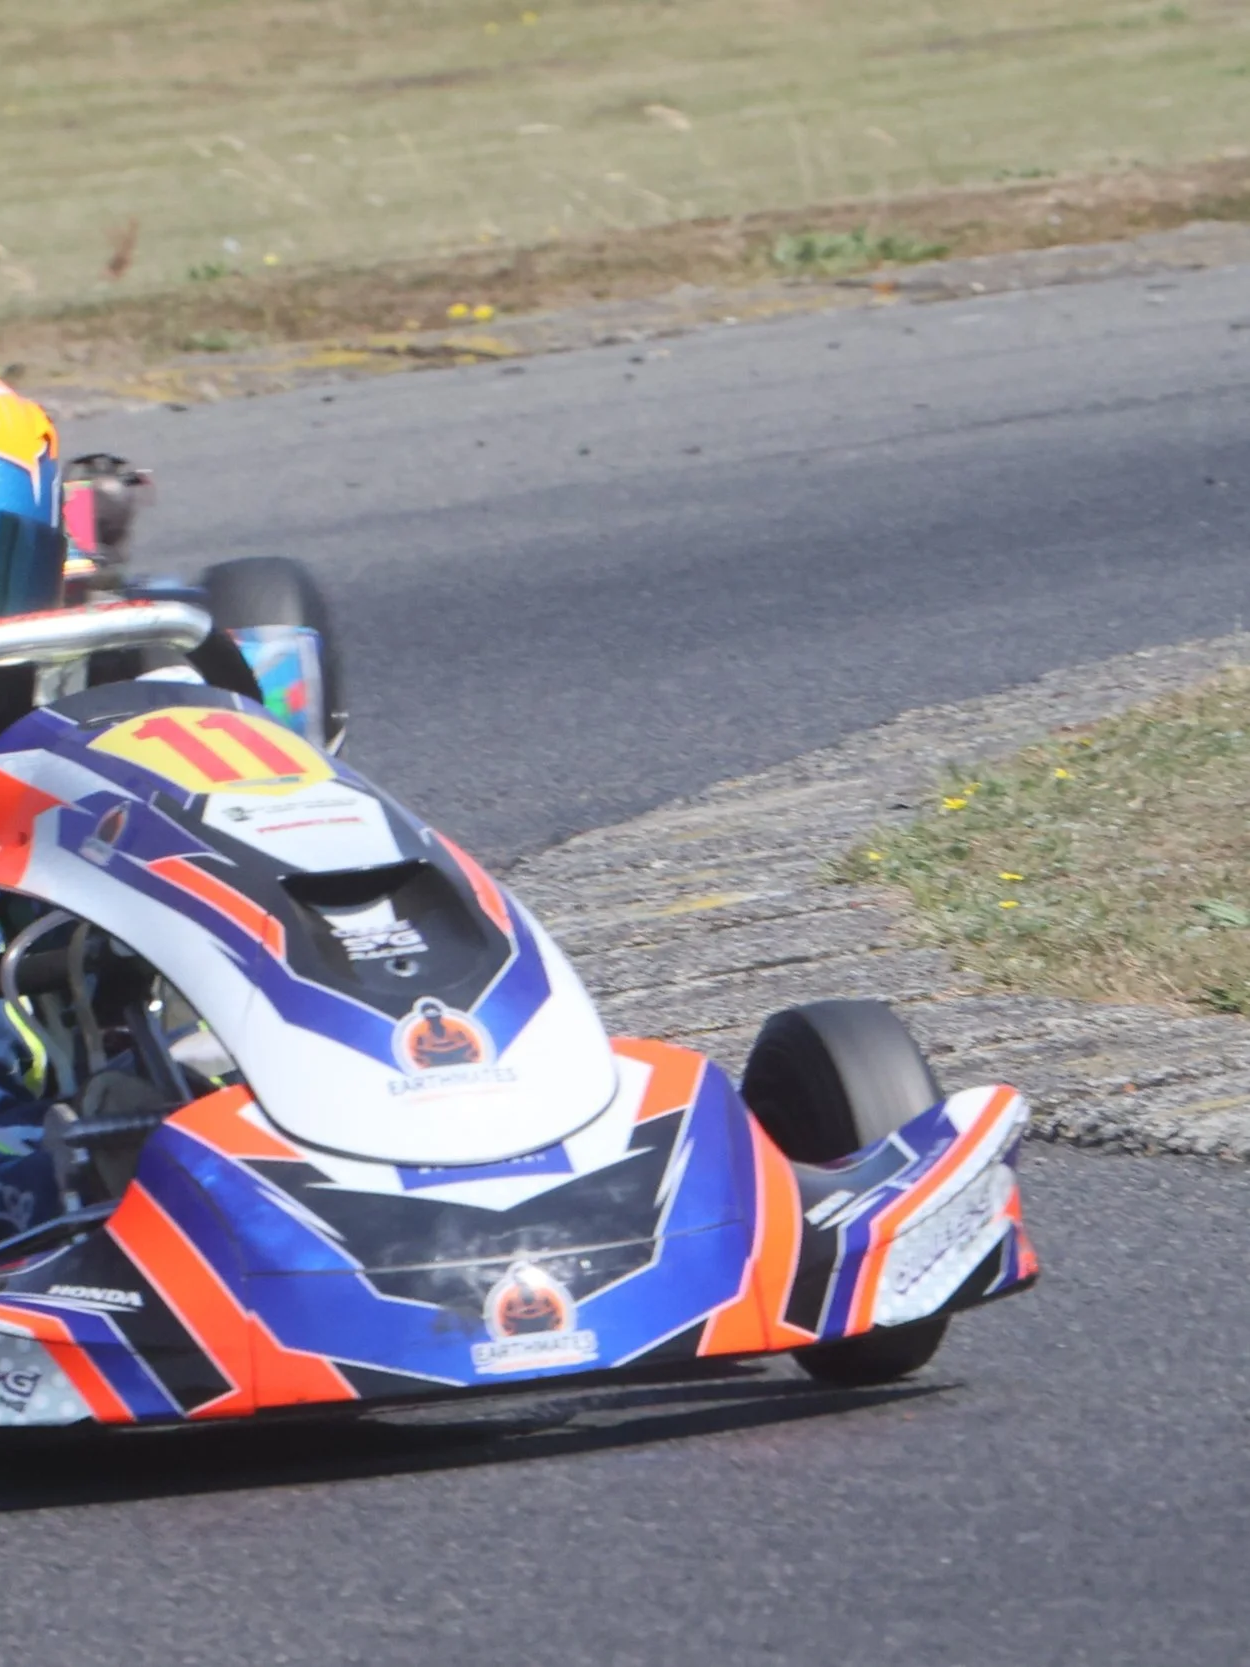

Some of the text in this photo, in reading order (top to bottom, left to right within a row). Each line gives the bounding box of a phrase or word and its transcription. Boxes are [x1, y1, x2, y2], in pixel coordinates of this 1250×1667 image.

[131, 712, 308, 783] 11
[387, 1066, 518, 1097] EARTHMATES
[47, 1285, 143, 1307] HONDA
